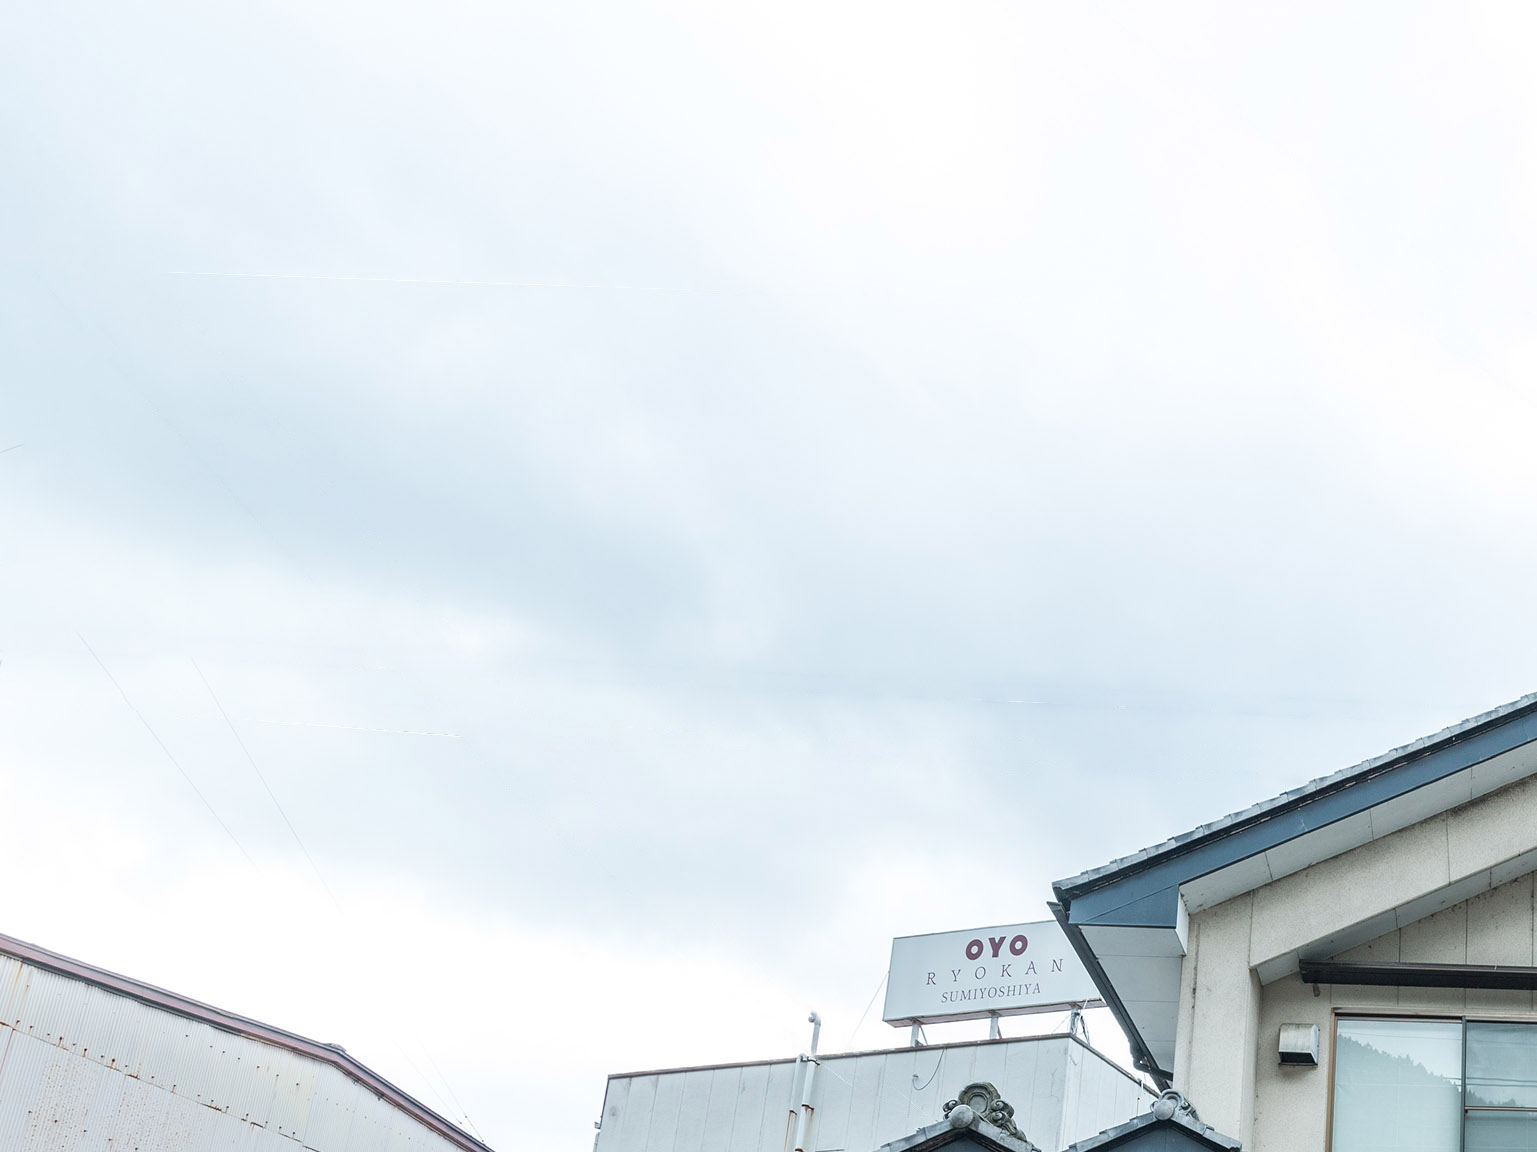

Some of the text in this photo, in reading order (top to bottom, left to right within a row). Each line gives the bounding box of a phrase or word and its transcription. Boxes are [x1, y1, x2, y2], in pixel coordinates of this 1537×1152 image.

[965, 934, 1029, 961] OYO
[926, 958, 1064, 986] RYOKAN
[941, 982, 1041, 1003] SUMIYOSHIYA
